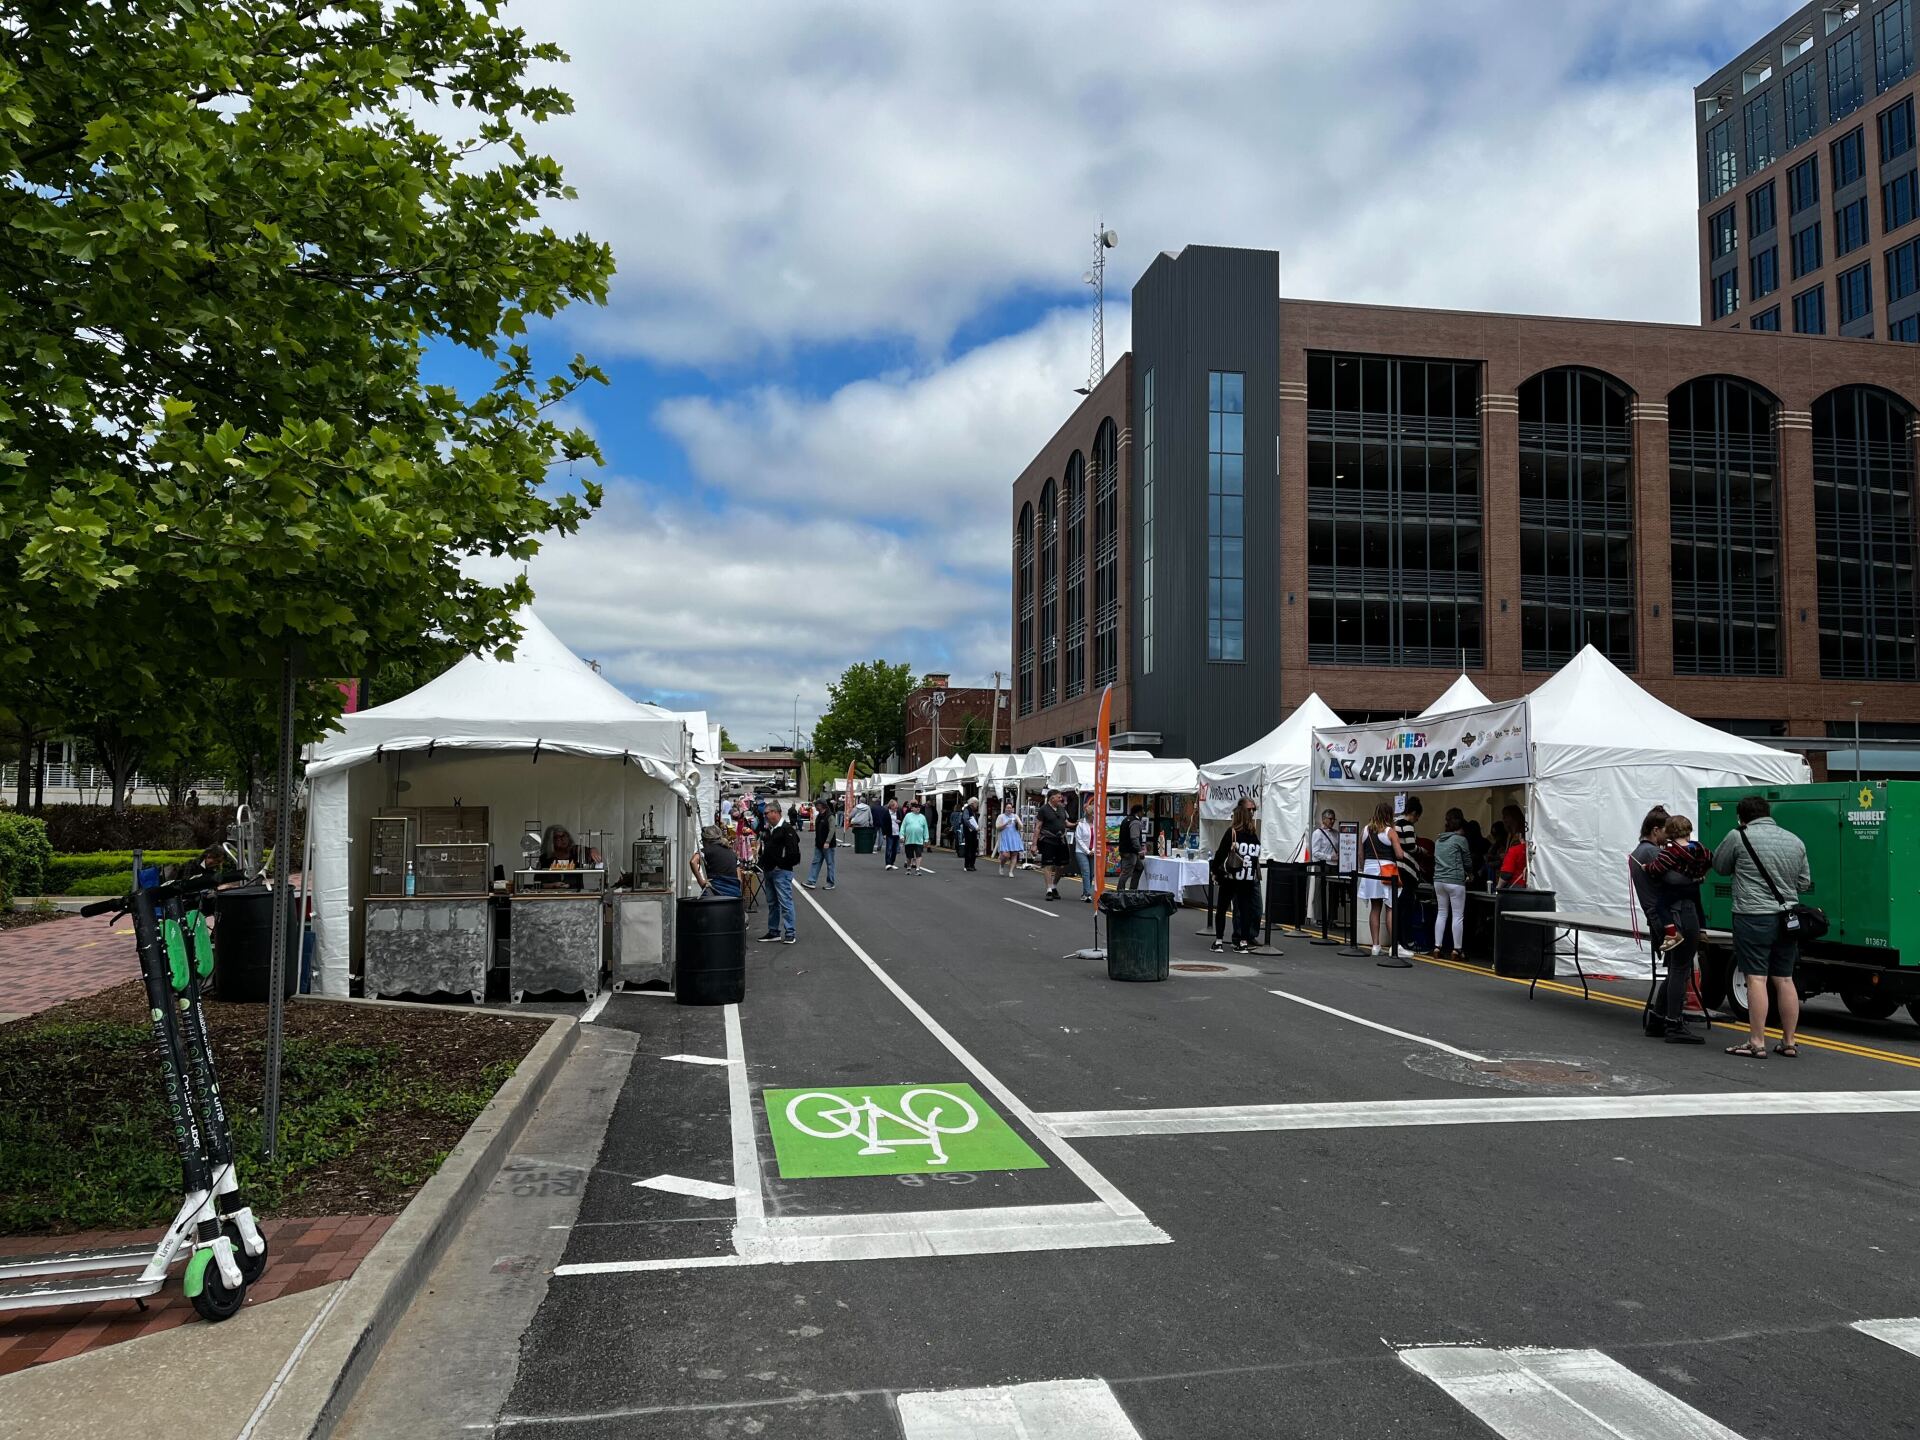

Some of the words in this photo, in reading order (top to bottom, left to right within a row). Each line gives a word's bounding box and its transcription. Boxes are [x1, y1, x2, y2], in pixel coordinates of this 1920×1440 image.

[1360, 748, 1457, 781] BEVERAGE
[1848, 811, 1886, 821] SUNBELT
[190, 1124, 201, 1149] Uber
[159, 1239, 174, 1258] Lime
